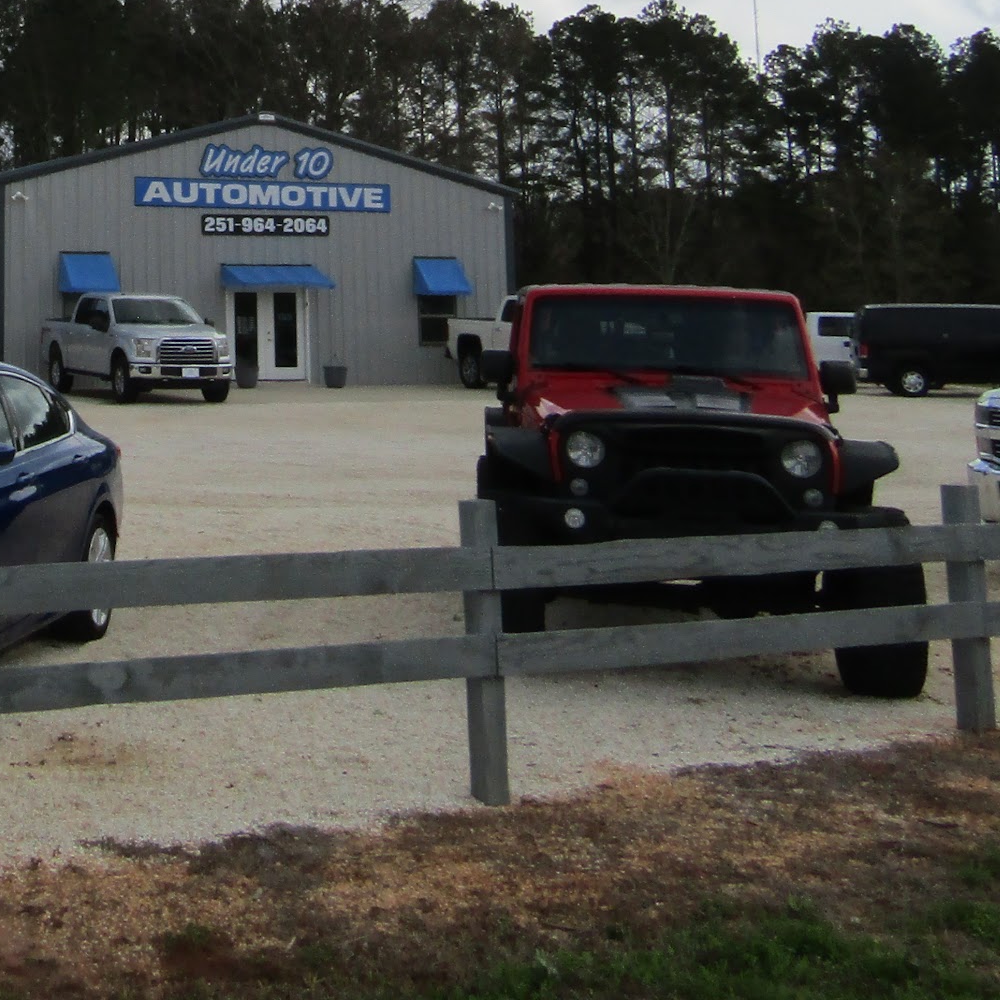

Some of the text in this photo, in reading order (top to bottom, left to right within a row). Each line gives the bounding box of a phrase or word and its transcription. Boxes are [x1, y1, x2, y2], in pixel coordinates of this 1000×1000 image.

[203, 147, 330, 176] Under 10
[142, 181, 384, 208] AUTOMOTIVE
[204, 216, 328, 234] 251-964-2064
